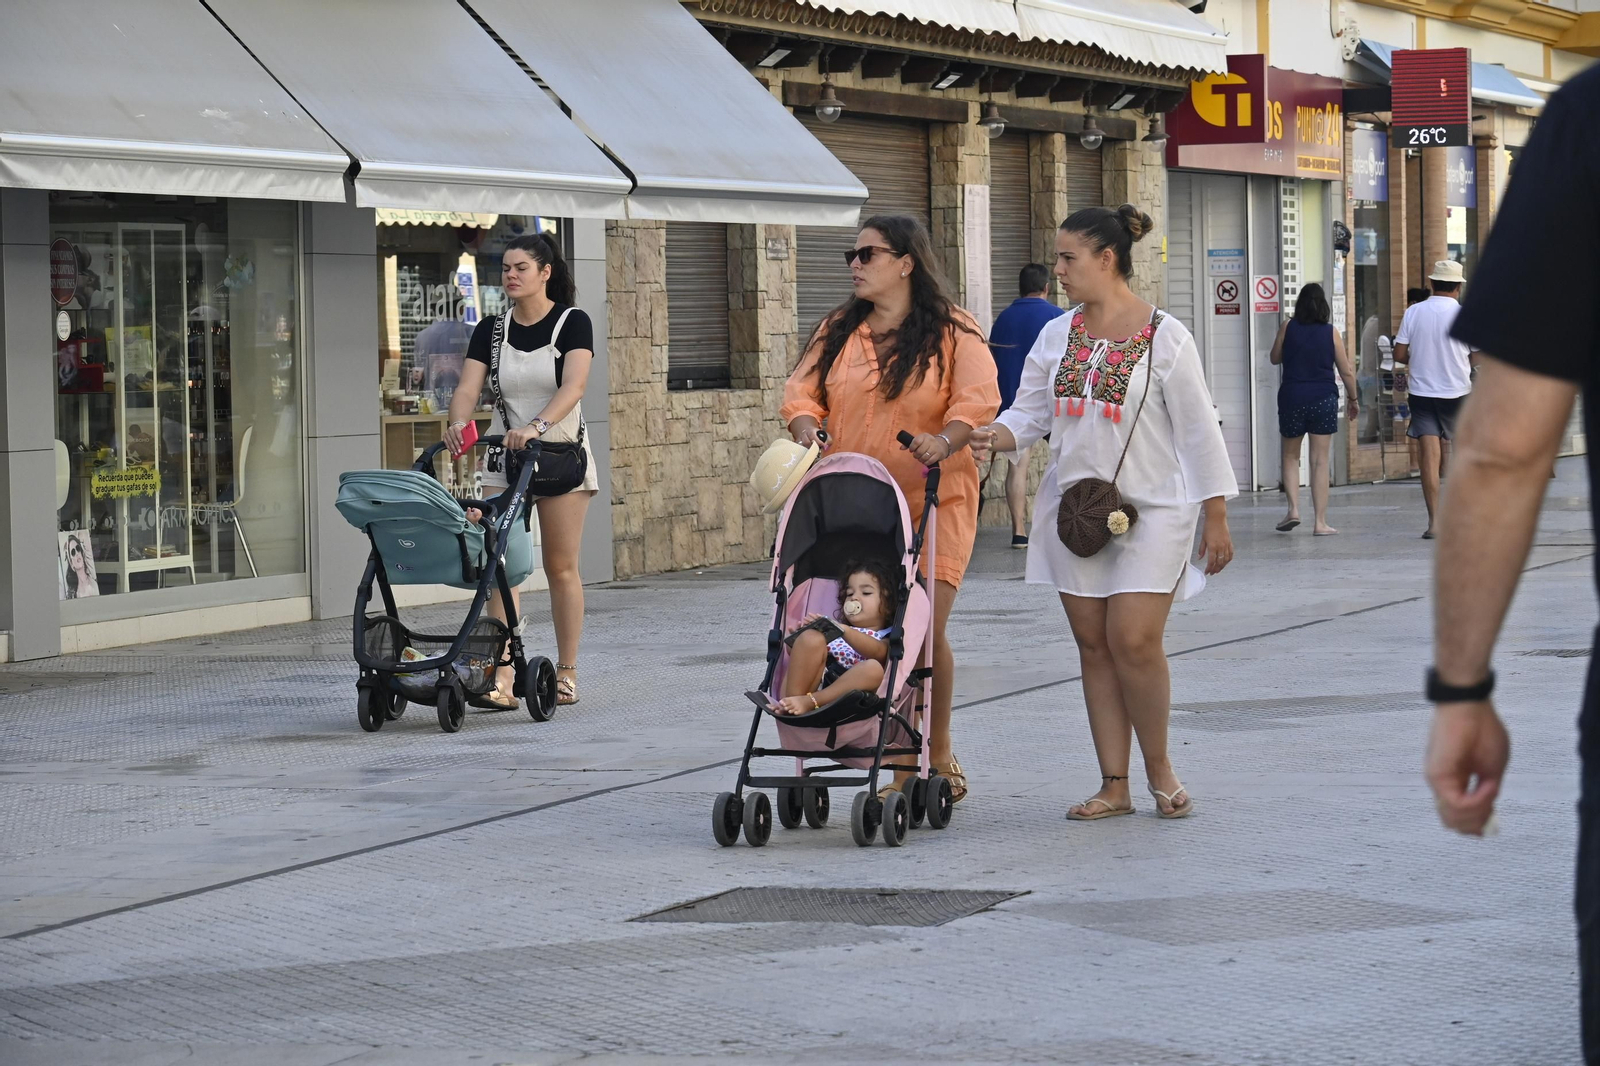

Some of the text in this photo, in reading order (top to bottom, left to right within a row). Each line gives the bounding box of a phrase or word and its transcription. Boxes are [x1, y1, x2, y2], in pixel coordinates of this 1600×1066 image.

[1326, 102, 1340, 147] 24
[492, 341, 501, 369] BIMBA
[95, 484, 116, 494] graduar
[126, 483, 141, 493] gafas
[149, 482, 157, 490] sol
[98, 473, 154, 482] Recuerda que puedes
[500, 519, 510, 529] be
[505, 504, 516, 519] cool
